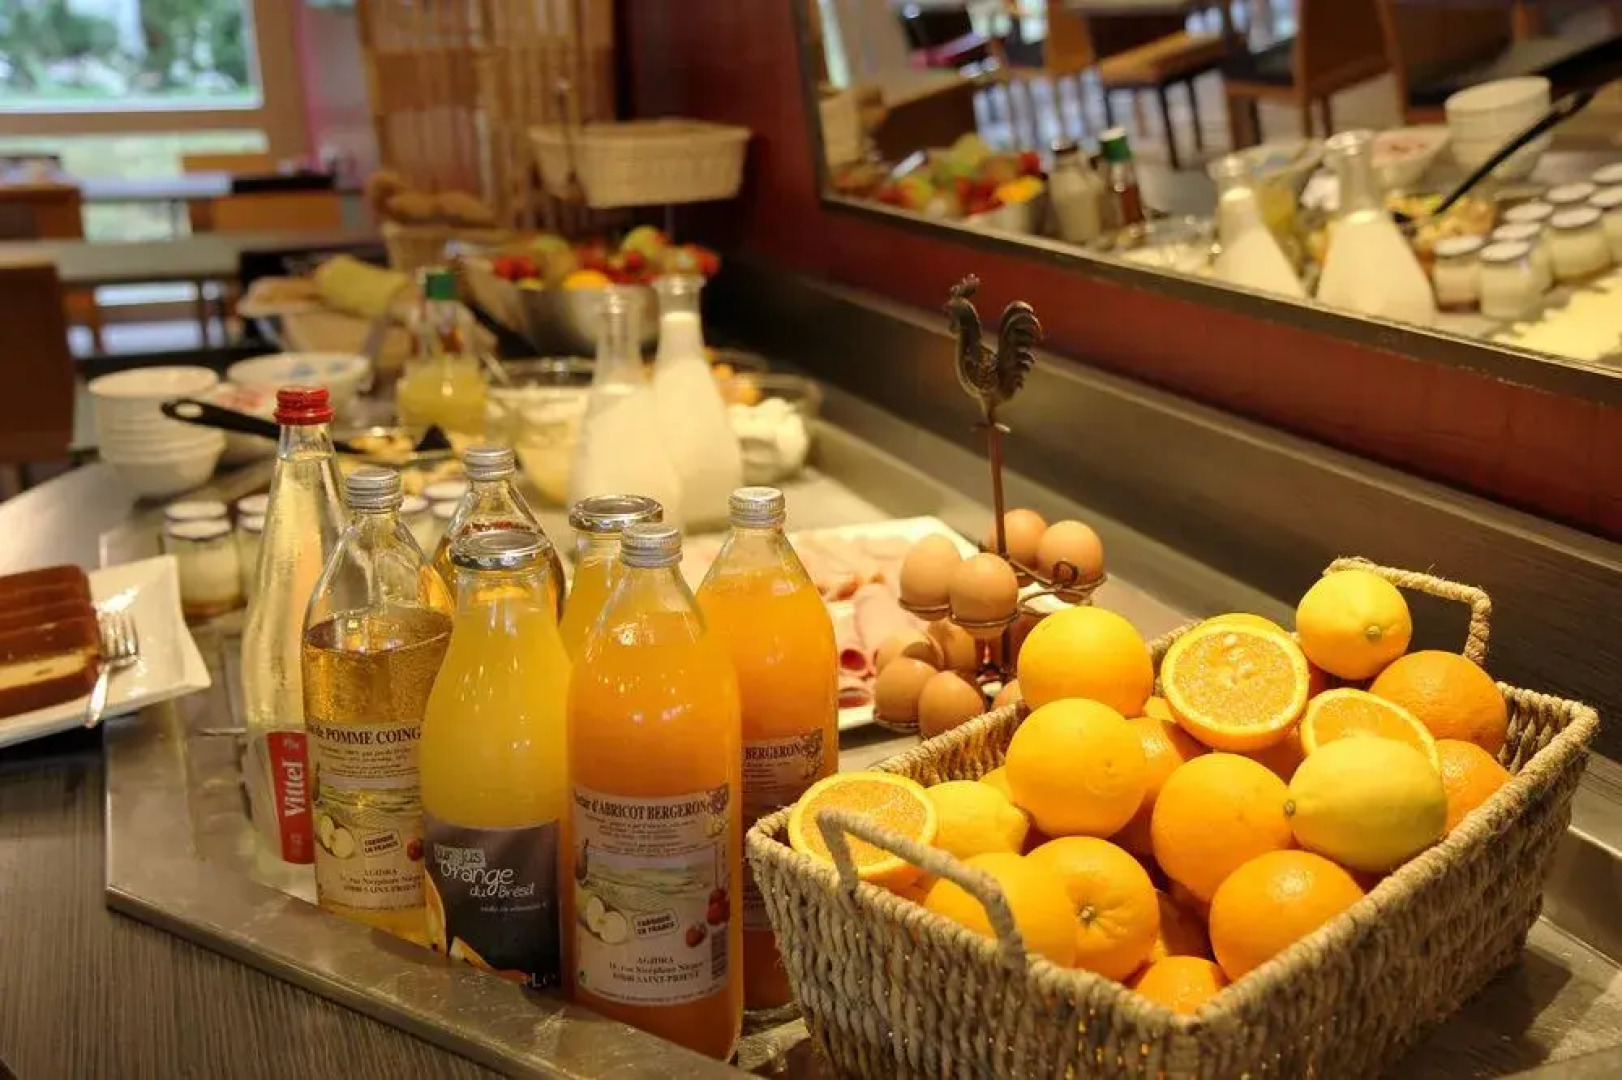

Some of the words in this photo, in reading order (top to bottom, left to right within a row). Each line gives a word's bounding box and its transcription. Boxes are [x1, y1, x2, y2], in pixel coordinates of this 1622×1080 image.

[325, 727, 373, 745] POMME
[376, 727, 421, 744] COING
[281, 759, 306, 817] Vittel
[646, 801, 708, 820] BERGERON
